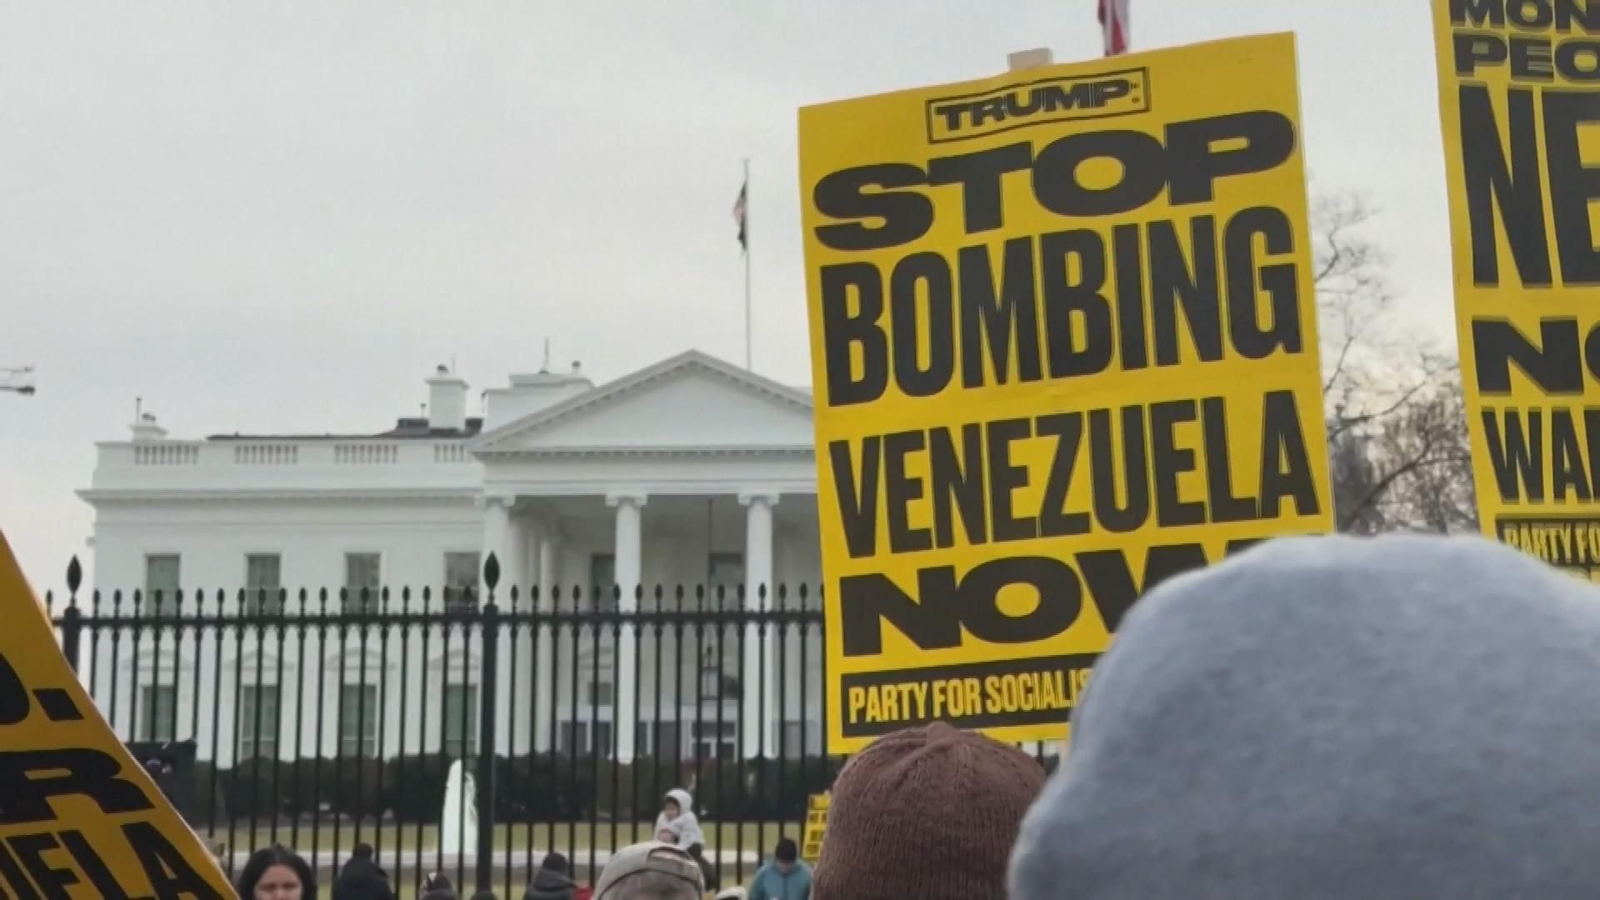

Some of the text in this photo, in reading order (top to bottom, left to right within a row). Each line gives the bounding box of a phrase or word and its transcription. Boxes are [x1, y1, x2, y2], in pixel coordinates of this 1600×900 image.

[1452, 29, 1600, 84] PEO
[813, 110, 1295, 251] STOP
[1457, 82, 1600, 288] NE
[819, 206, 1304, 407] BOMBING
[1471, 315, 1600, 397] N
[828, 389, 1321, 558] VENEZUELA
[848, 681, 928, 724] PARTY
[932, 677, 982, 718] FOR
[0, 820, 224, 900] ELA
